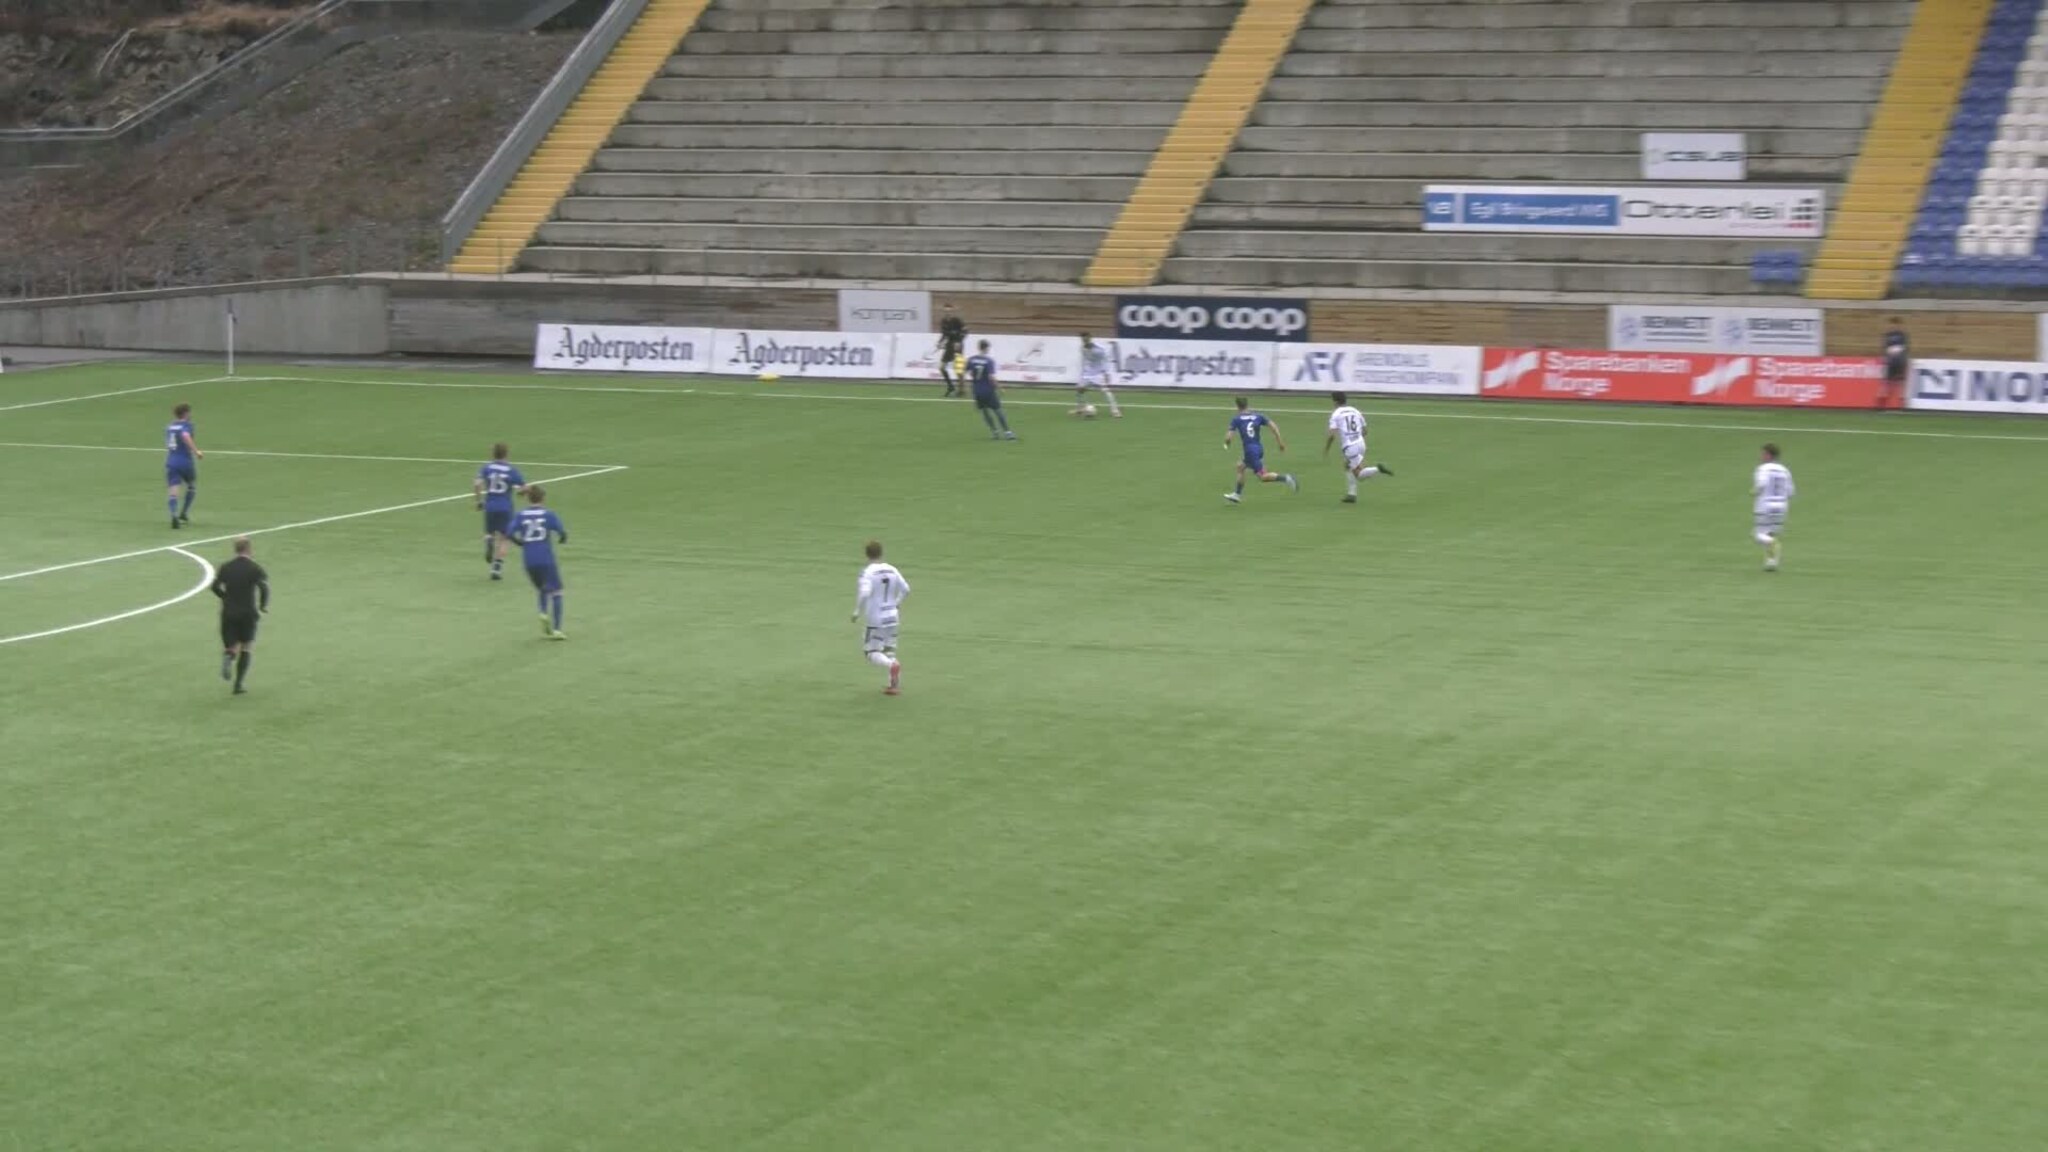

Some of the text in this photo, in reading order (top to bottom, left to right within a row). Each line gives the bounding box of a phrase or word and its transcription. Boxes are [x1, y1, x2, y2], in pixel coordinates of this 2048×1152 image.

[1624, 200, 1785, 220] Otterlei
[1120, 305, 1307, 336] coop coop
[554, 327, 694, 370] Agderposten
[728, 332, 874, 374] Agderposten
[1294, 351, 1346, 382] AFK
[1545, 351, 1692, 374] Sparebanken
[1543, 373, 1612, 396] Norge
[1753, 378, 1826, 402] Norge
[1246, 421, 1255, 438] 6
[1344, 414, 1358, 432] 16
[487, 472, 509, 494] 15
[522, 518, 547, 542] 25
[881, 577, 890, 603] 7
